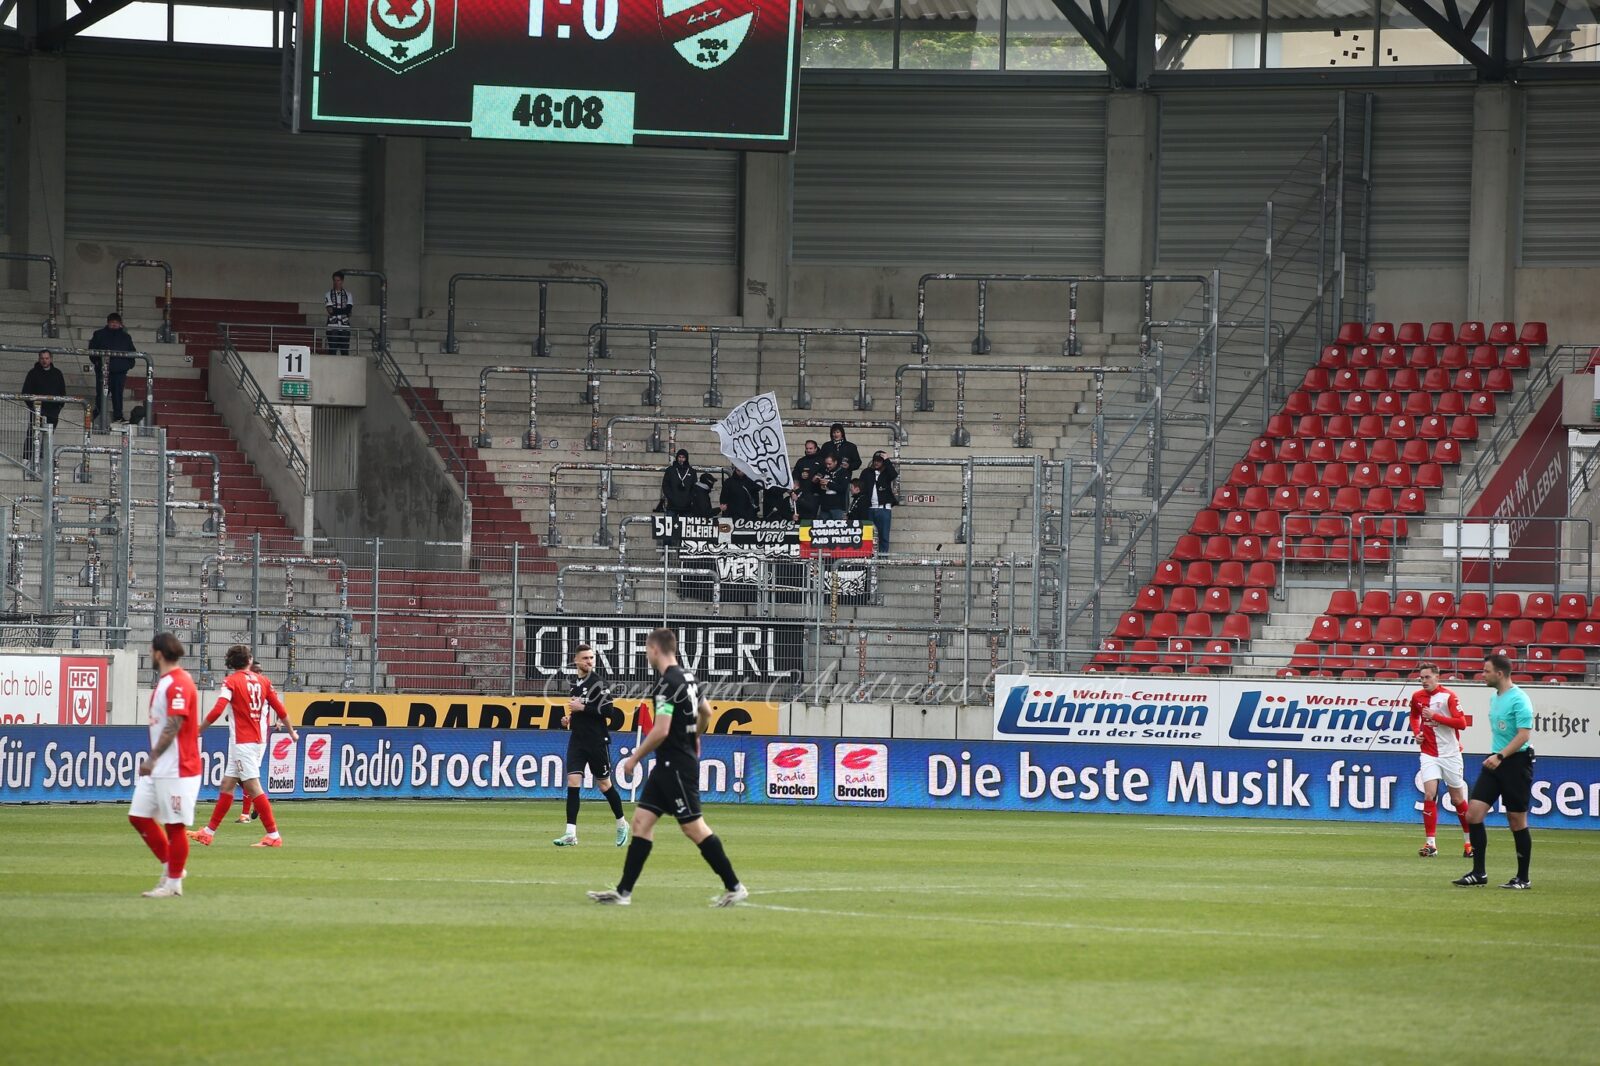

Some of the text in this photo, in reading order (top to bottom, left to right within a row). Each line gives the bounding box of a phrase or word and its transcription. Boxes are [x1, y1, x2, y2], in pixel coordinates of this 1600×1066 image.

[512, 94, 604, 129] 46:08
[285, 353, 302, 372] 11
[734, 518, 796, 531] Casuals
[812, 519, 848, 528] BLOCK
[756, 531, 785, 543] Verl
[679, 627, 791, 677] VERL
[24, 670, 52, 696] tolle
[71, 672, 95, 687] HFC
[247, 682, 262, 711] 33
[1073, 689, 1208, 702] Wohn-Centrum
[1306, 695, 1412, 707] Wohn-Cent
[997, 685, 1209, 736] Lührmann
[1228, 691, 1412, 741] Lührman
[1534, 712, 1590, 738] tritzer
[1077, 728, 1202, 739] an der Saline
[1341, 734, 1373, 744] der
[1378, 735, 1416, 745] Sali
[340, 739, 403, 787] Radio
[411, 740, 563, 788] Brocken
[269, 777, 293, 789] Brocken
[305, 776, 327, 788] Brocken
[776, 772, 806, 782] Radio
[845, 773, 875, 784] Radio
[928, 751, 1001, 797] Die
[1020, 751, 1150, 802] beste
[1167, 759, 1311, 806] Musik
[1327, 760, 1397, 809] für
[769, 783, 815, 795] Brocken
[838, 785, 884, 798] Brocken
